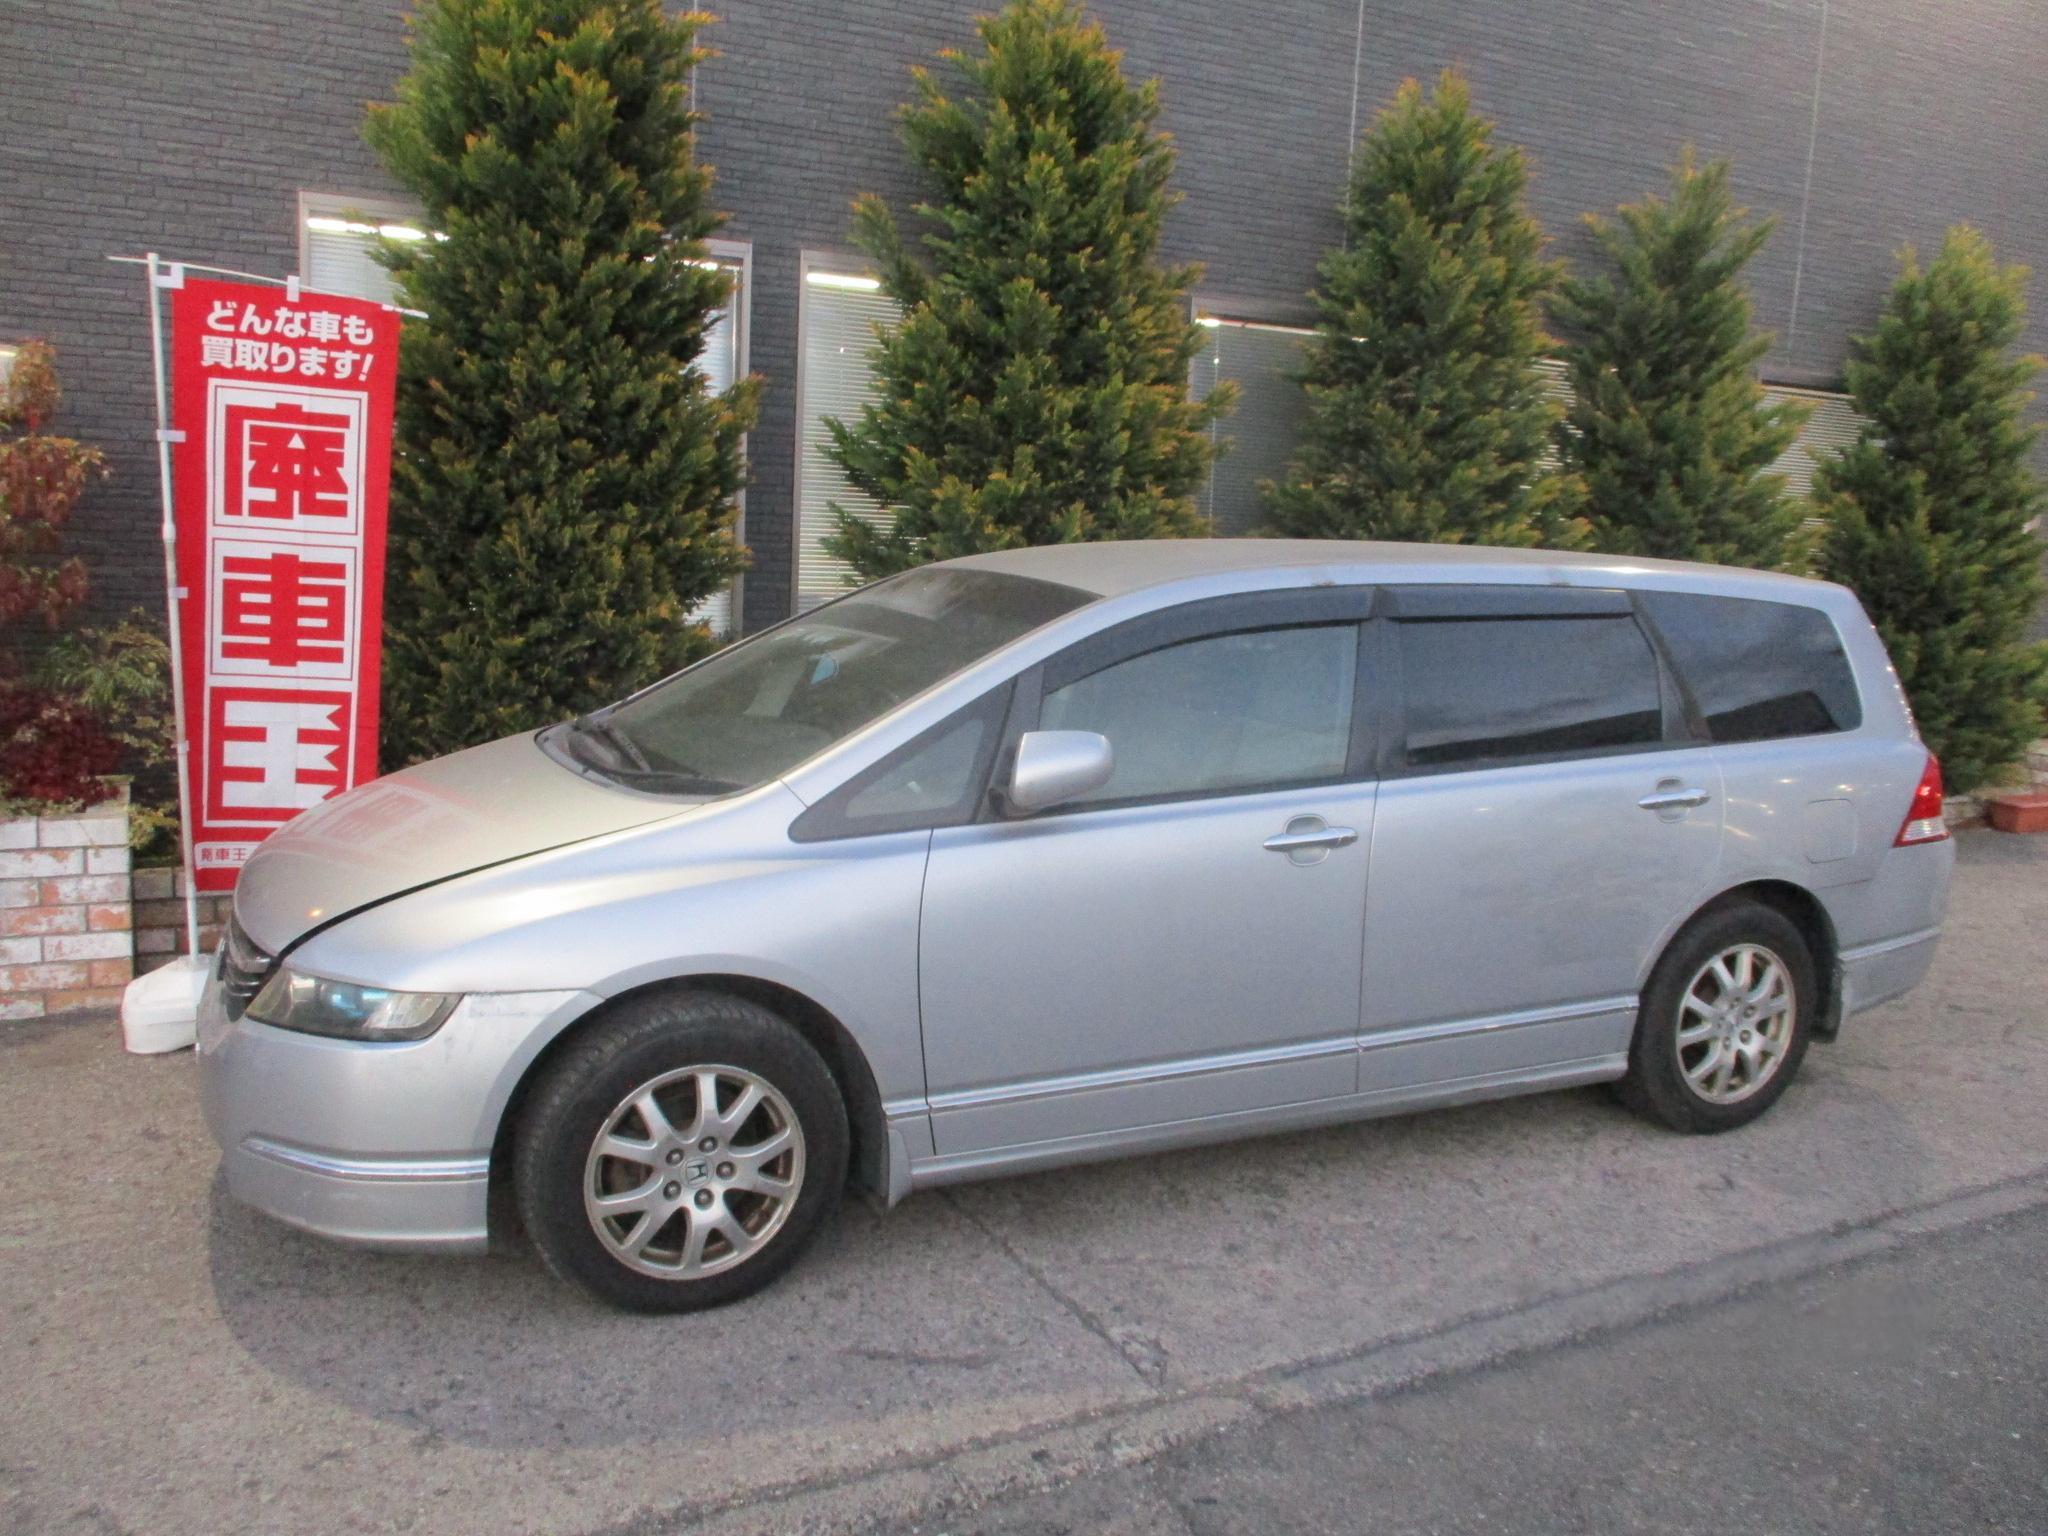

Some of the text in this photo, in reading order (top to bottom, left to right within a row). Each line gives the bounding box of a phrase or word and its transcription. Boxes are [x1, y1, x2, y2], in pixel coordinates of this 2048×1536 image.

[206, 300, 374, 346] どんな車も
[201, 335, 375, 382] 買取ります!
